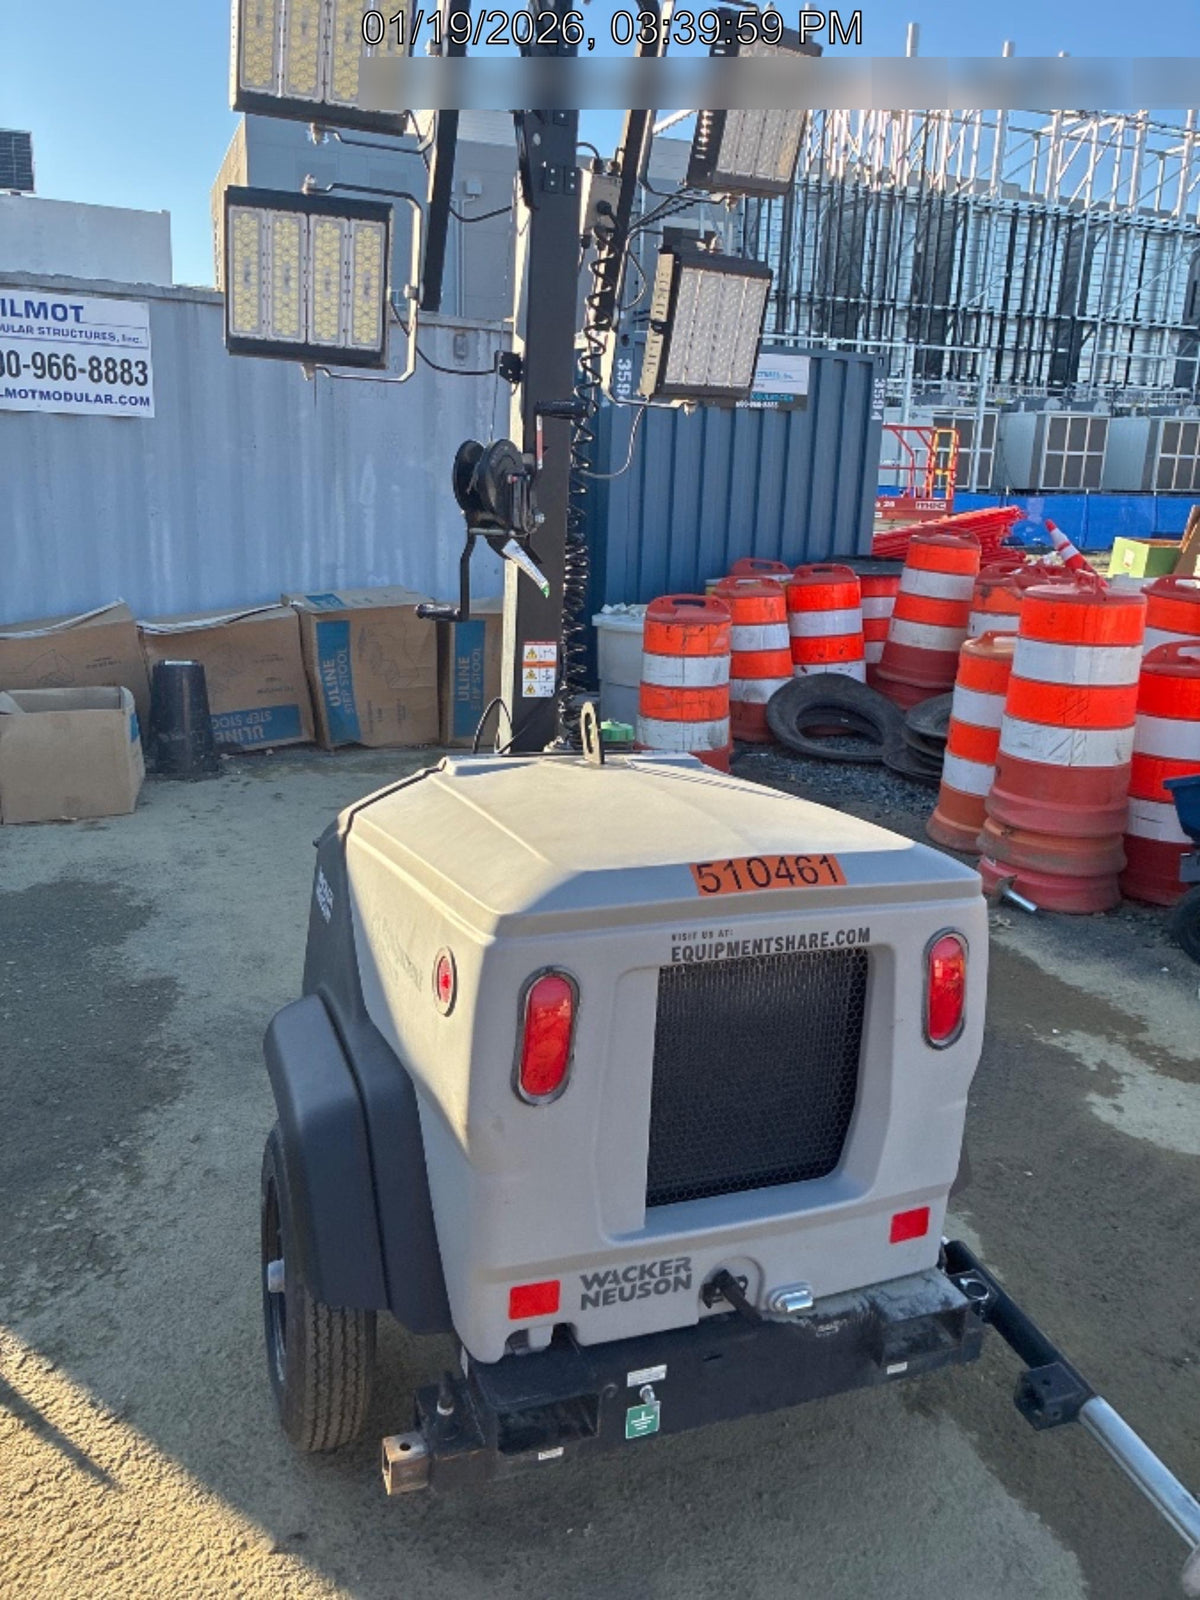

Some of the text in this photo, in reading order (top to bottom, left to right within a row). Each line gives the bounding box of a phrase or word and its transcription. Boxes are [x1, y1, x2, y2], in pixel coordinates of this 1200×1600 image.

[37, 326, 120, 343] STRUCTURES,
[323, 658, 342, 707] ULINE
[458, 656, 471, 702] ULINE
[696, 854, 838, 893] 510461
[671, 927, 871, 962] EQUIPMENTSHARE.COM
[580, 1256, 692, 1291] WACKER
[581, 1273, 692, 1311] NEUSON
